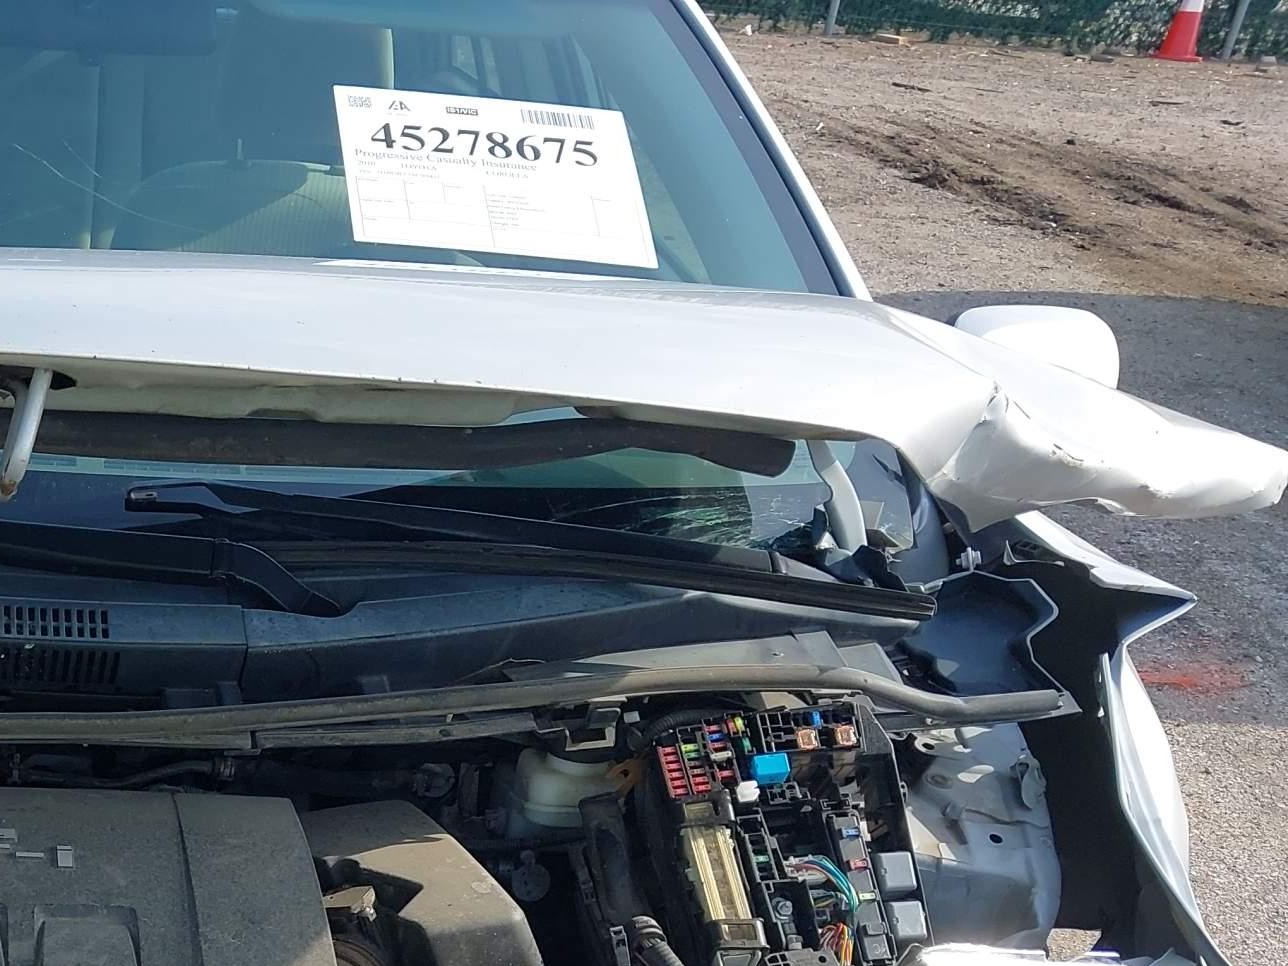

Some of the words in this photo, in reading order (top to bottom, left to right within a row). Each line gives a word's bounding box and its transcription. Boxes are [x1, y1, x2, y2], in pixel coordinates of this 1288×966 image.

[354, 148, 424, 163] Progressive
[426, 153, 478, 168] Casualty
[481, 158, 537, 172] Insurance
[370, 122, 598, 167] 45278675
